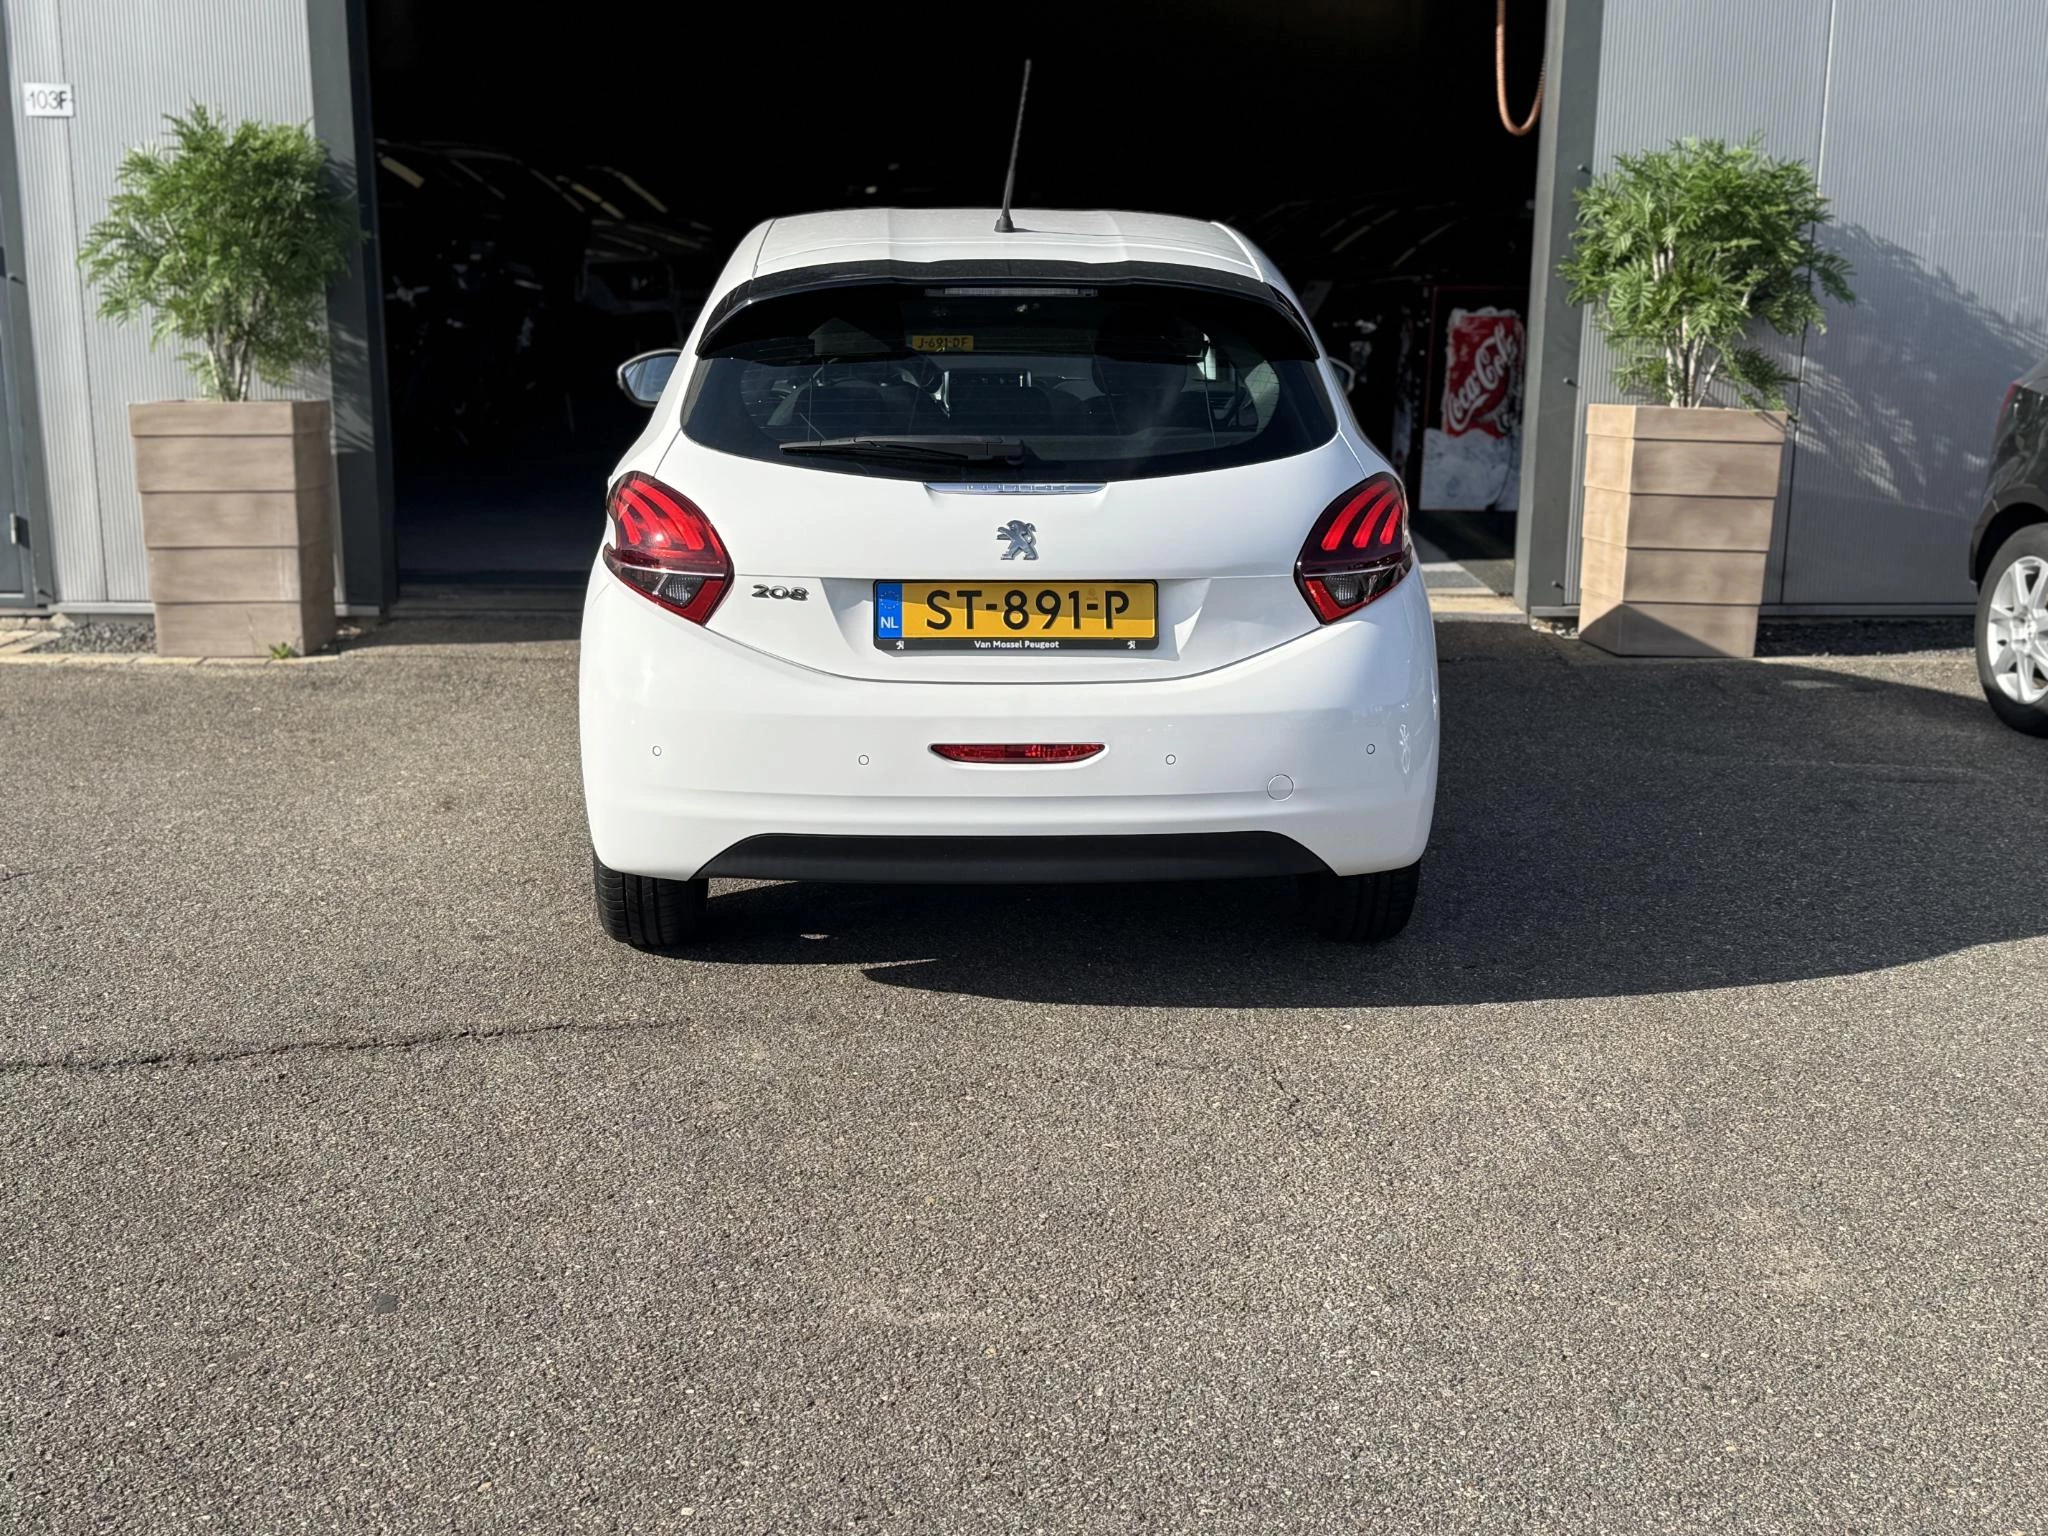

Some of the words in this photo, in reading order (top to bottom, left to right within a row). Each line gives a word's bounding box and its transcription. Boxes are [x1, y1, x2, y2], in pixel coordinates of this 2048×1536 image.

[30, 90, 67, 110] 103F
[752, 584, 809, 601] 208
[926, 589, 1130, 630] ST-891-P
[881, 617, 899, 629] NL
[974, 640, 991, 648] Van
[993, 640, 1023, 648] Mossel
[1025, 640, 1060, 650] Peugeot
